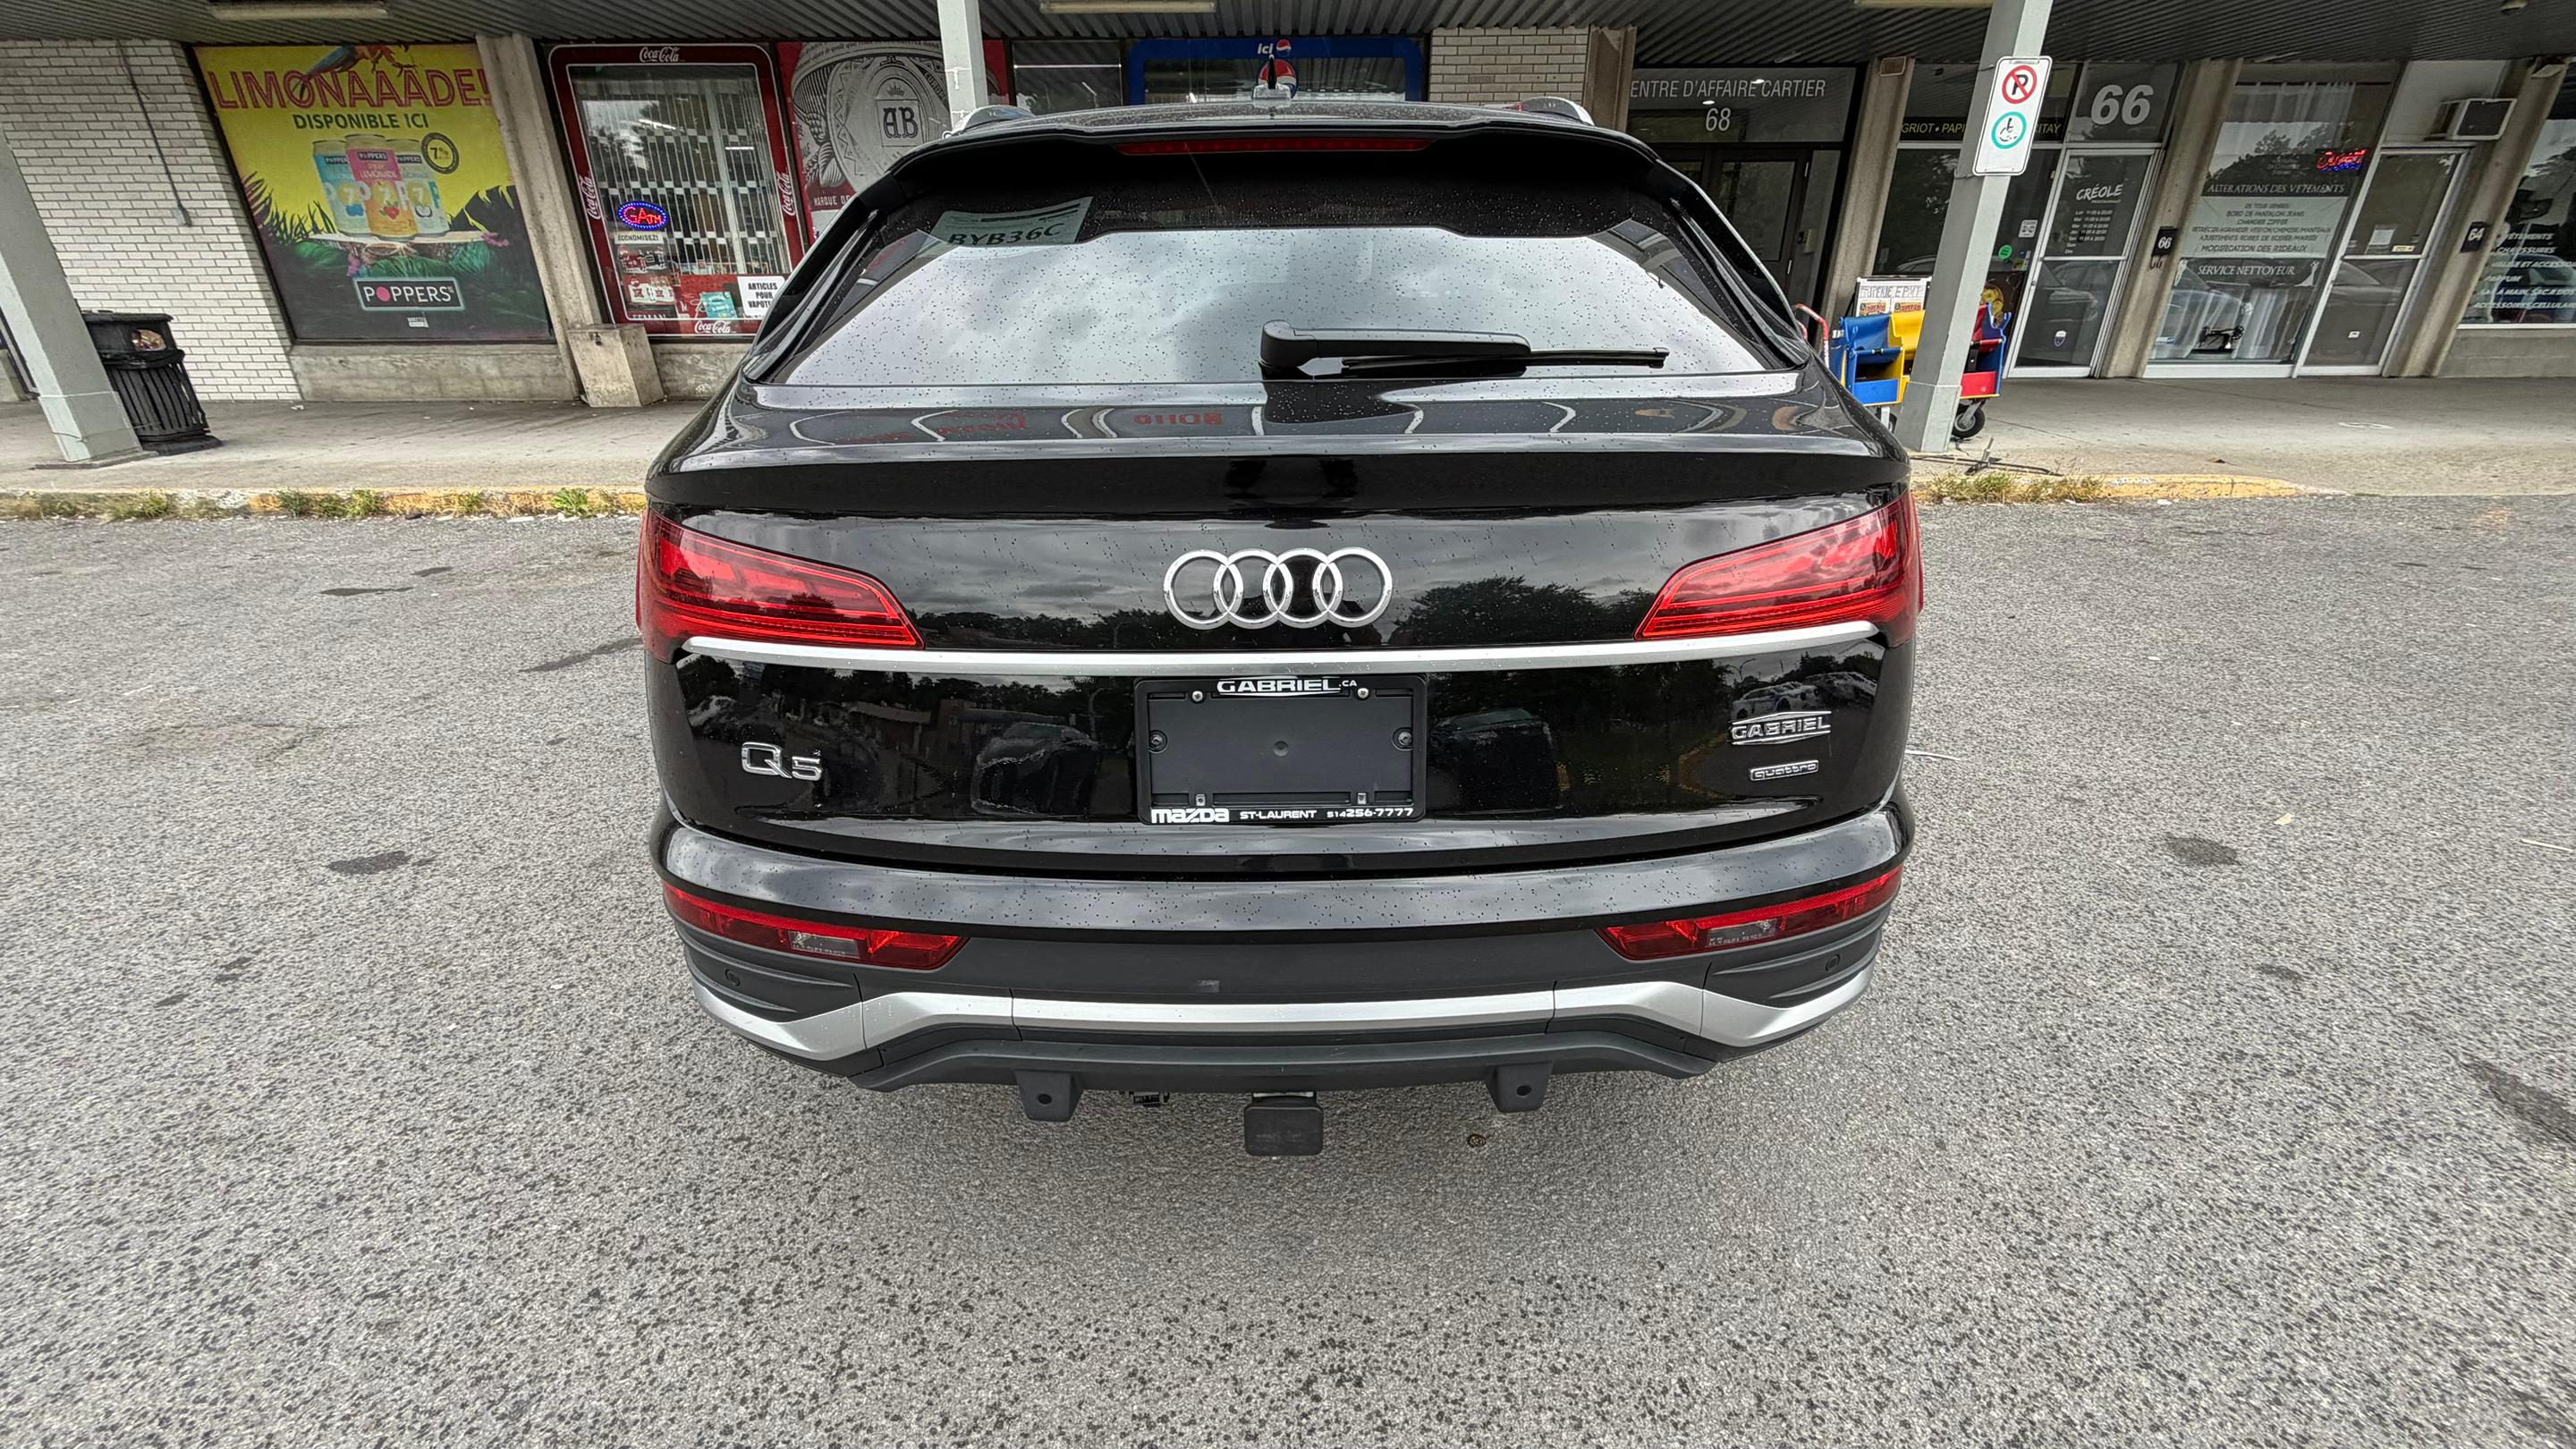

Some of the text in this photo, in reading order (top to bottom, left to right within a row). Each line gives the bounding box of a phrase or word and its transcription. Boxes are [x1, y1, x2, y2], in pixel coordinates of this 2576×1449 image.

[1630, 79, 1826, 97] ENTRE D'AFFAIRE CARTIER
[2091, 84, 2154, 125] 66
[292, 113, 429, 130] DISPONIBLE ICI
[883, 106, 919, 139] AB
[1705, 107, 1732, 132] 68
[1901, 123, 1936, 134] GRIOT
[2036, 123, 2062, 134] ITAY
[2075, 183, 2123, 201] CRÉOLE
[813, 196, 838, 206] MARQUE
[947, 223, 1064, 246] BYB36C
[2468, 227, 2486, 242] 64
[2157, 236, 2173, 250] 66
[2200, 244, 2309, 252] MODIFICATION DES RIDEAUX
[2197, 265, 2296, 275] SERVICE NETTOYEUR
[363, 285, 452, 302] POPPERS
[748, 282, 778, 291] ARTICLES
[756, 292, 774, 300] POUR
[1732, 716, 1832, 740] GABRIEL
[741, 741, 822, 781] Q5
[1754, 763, 1817, 779] quattro
[1239, 810, 1318, 820] ST-LAURENT
